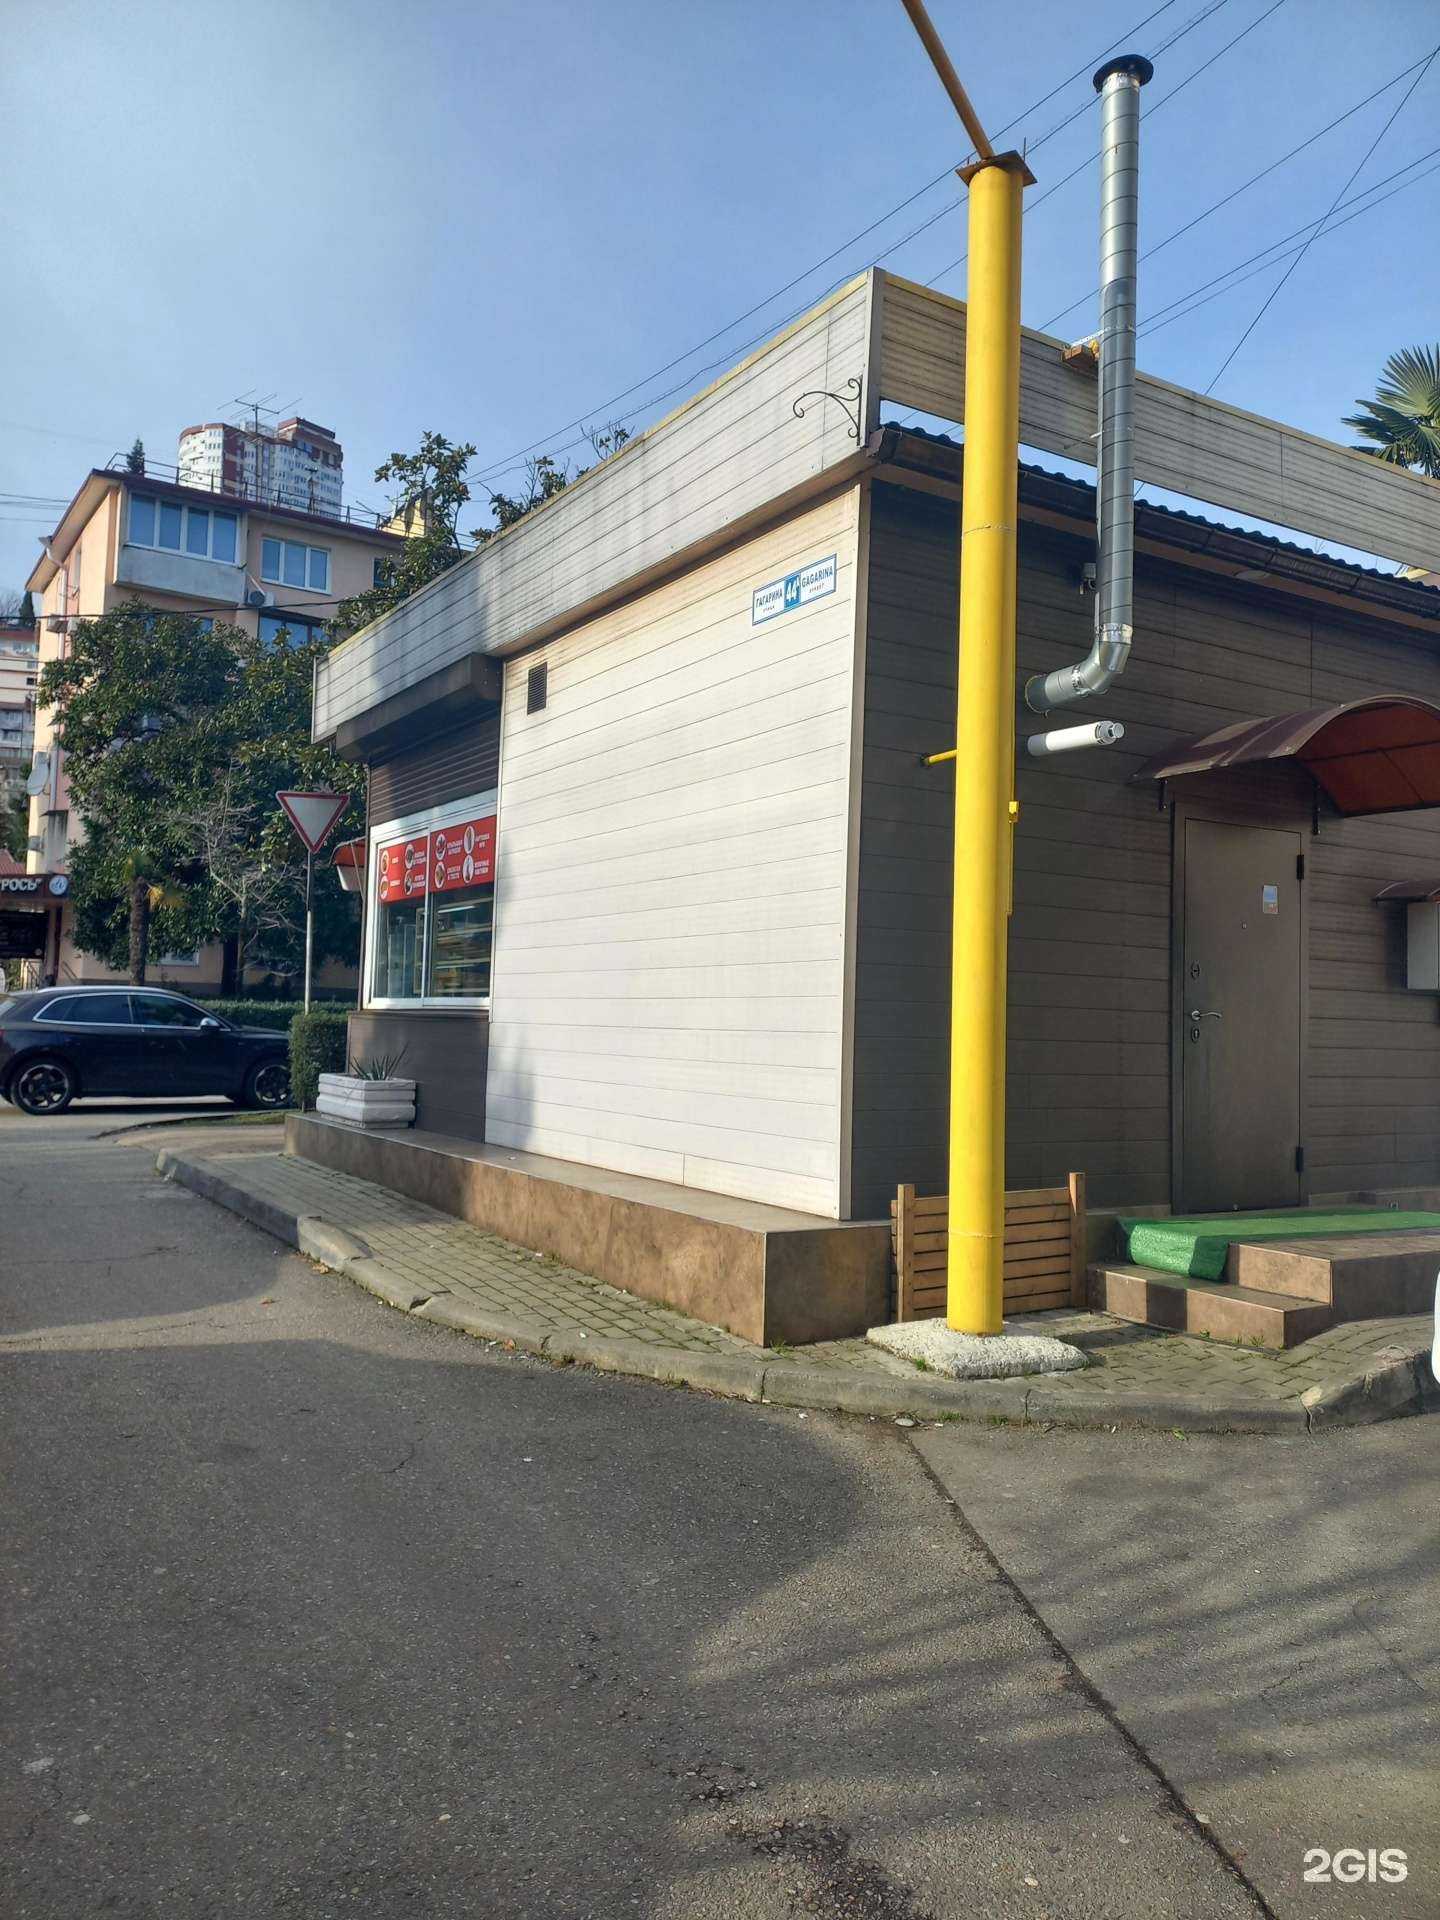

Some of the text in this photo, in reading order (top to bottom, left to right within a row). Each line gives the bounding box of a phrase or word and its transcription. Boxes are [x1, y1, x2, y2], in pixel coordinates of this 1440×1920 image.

[802, 566, 833, 588] GAGARINA
[756, 588, 783, 608] ГАГАРИНА
[0, 878, 42, 891] РОСЬ"
